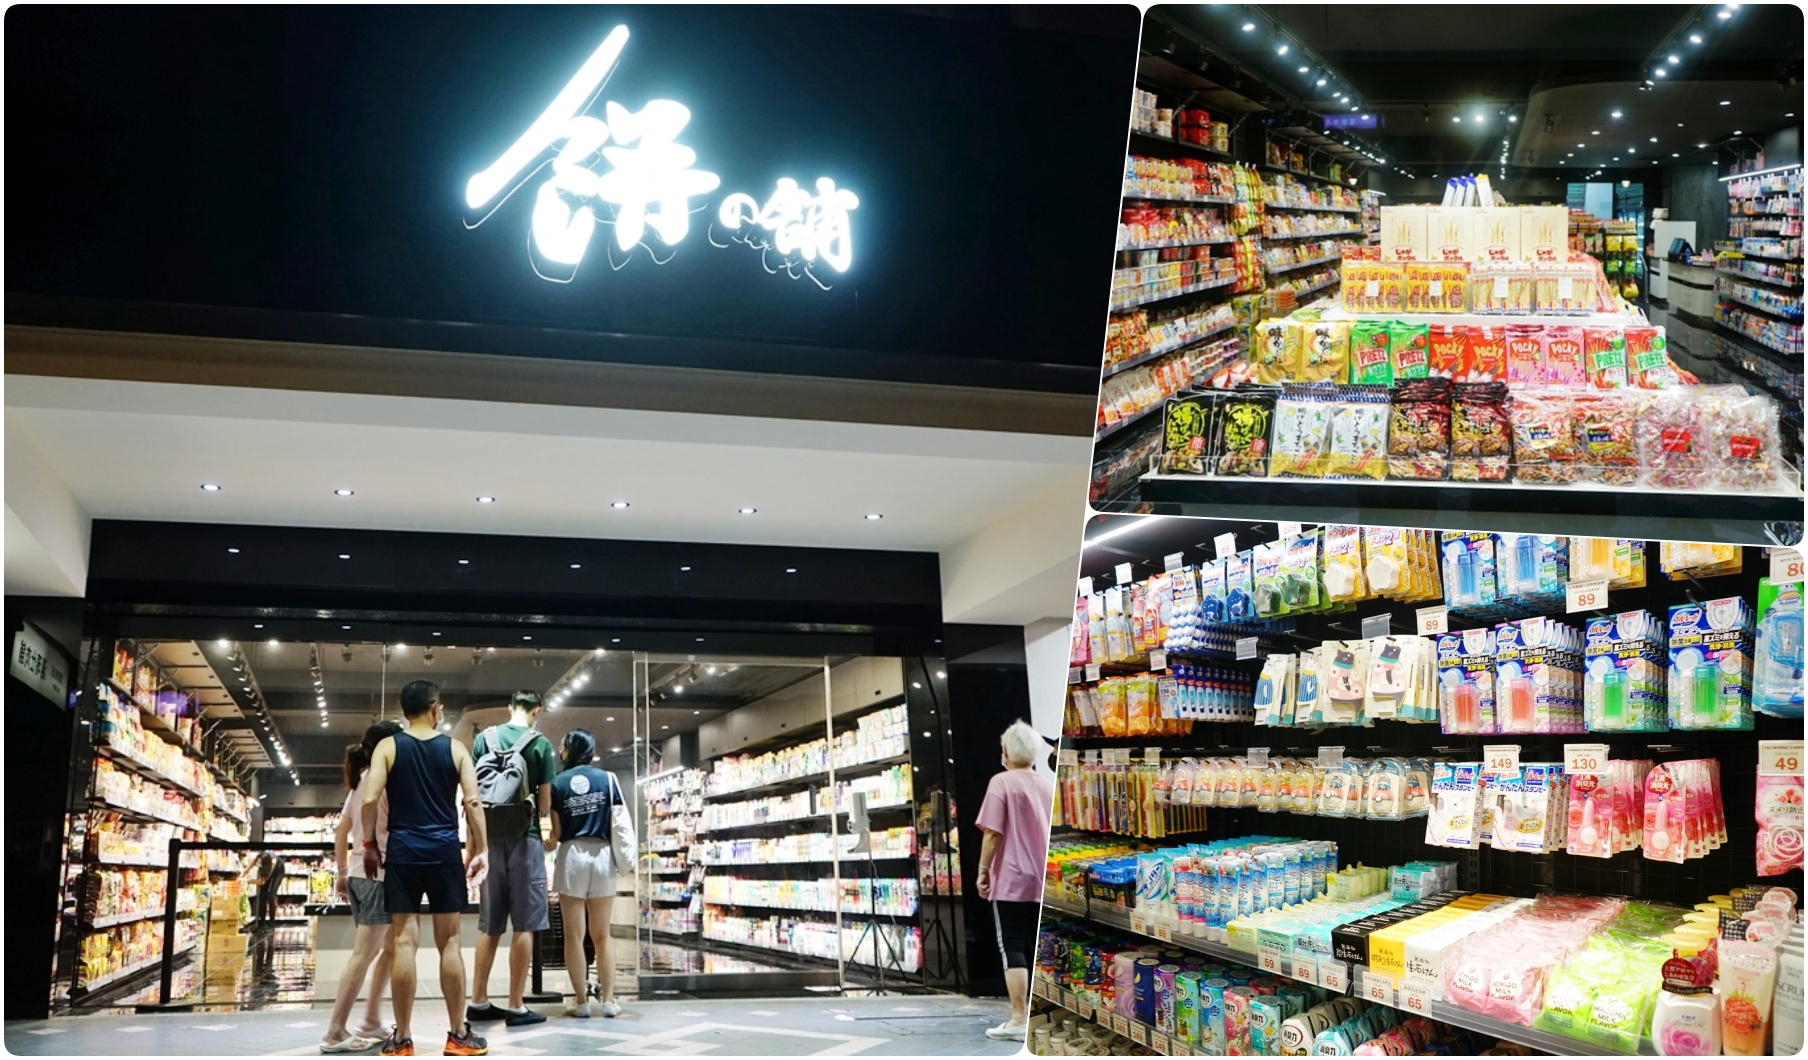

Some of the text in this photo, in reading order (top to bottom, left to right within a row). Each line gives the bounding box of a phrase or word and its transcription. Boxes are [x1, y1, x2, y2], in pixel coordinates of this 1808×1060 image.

[1359, 348, 1387, 366] PRETZ
[1398, 350, 1426, 366] PRETZ
[1596, 352, 1624, 368] PRETZ
[1638, 353, 1665, 370] PRETZ
[1578, 593, 1596, 606] 89
[1426, 620, 1439, 630] 89
[1491, 758, 1512, 769] 149
[1572, 758, 1597, 770] 130
[1775, 757, 1798, 770] 49
[1264, 958, 1275, 969] 59
[1406, 960, 1438, 978] 生石けん
[1298, 968, 1310, 978] 89
[1458, 971, 1479, 984] ICHIGO
[1326, 976, 1338, 987] 65
[1458, 978, 1472, 987] MILK
[1492, 980, 1517, 989] ICHIGO
[1371, 987, 1384, 1000] 65
[1777, 982, 1804, 996] SCRU
[1408, 997, 1422, 1010] 65
[1594, 1006, 1627, 1020] MACCHA
[1598, 1014, 1616, 1023] MILK
